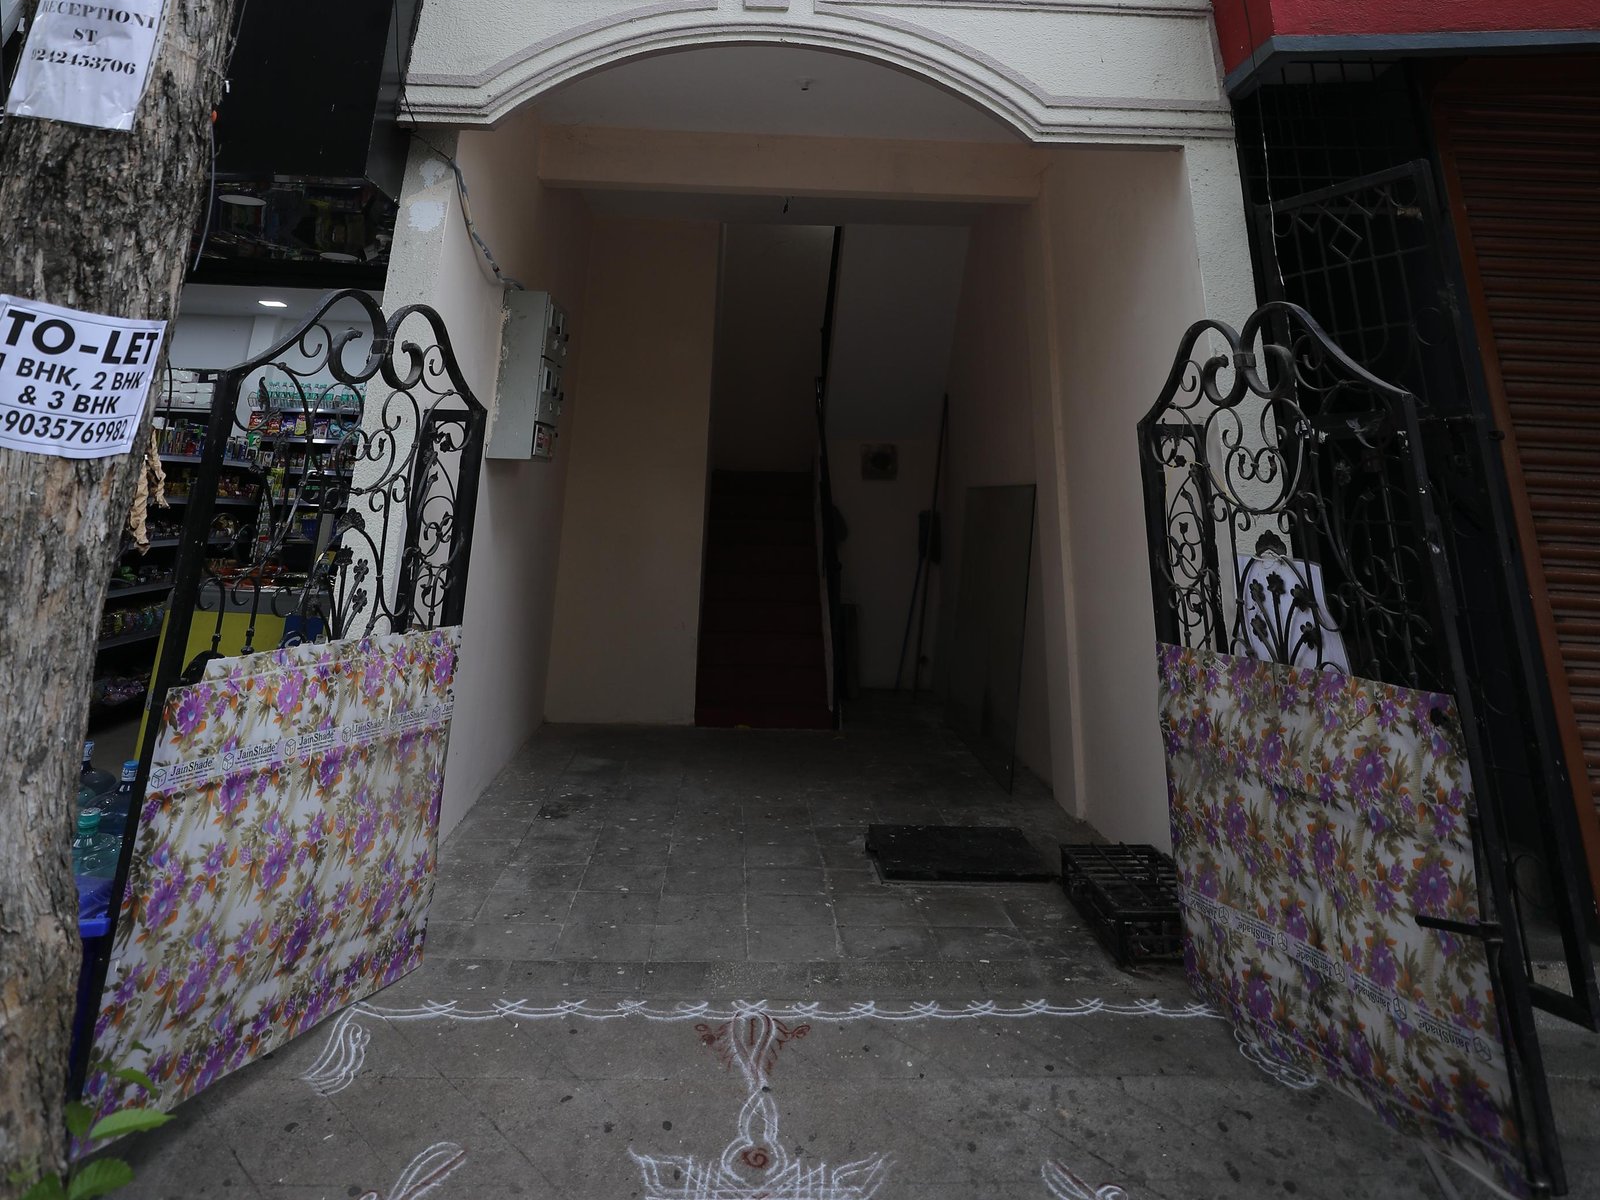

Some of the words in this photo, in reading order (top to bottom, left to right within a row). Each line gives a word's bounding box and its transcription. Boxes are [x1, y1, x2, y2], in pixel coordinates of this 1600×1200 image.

[72, 27, 98, 43] ST
[5, 309, 159, 365] TO-LET
[16, 357, 81, 391] BHK,
[90, 371, 107, 391] 2
[111, 371, 145, 391] BHK
[18, 385, 37, 405] &
[47, 390, 66, 410] 3
[72, 394, 121, 415] BHK
